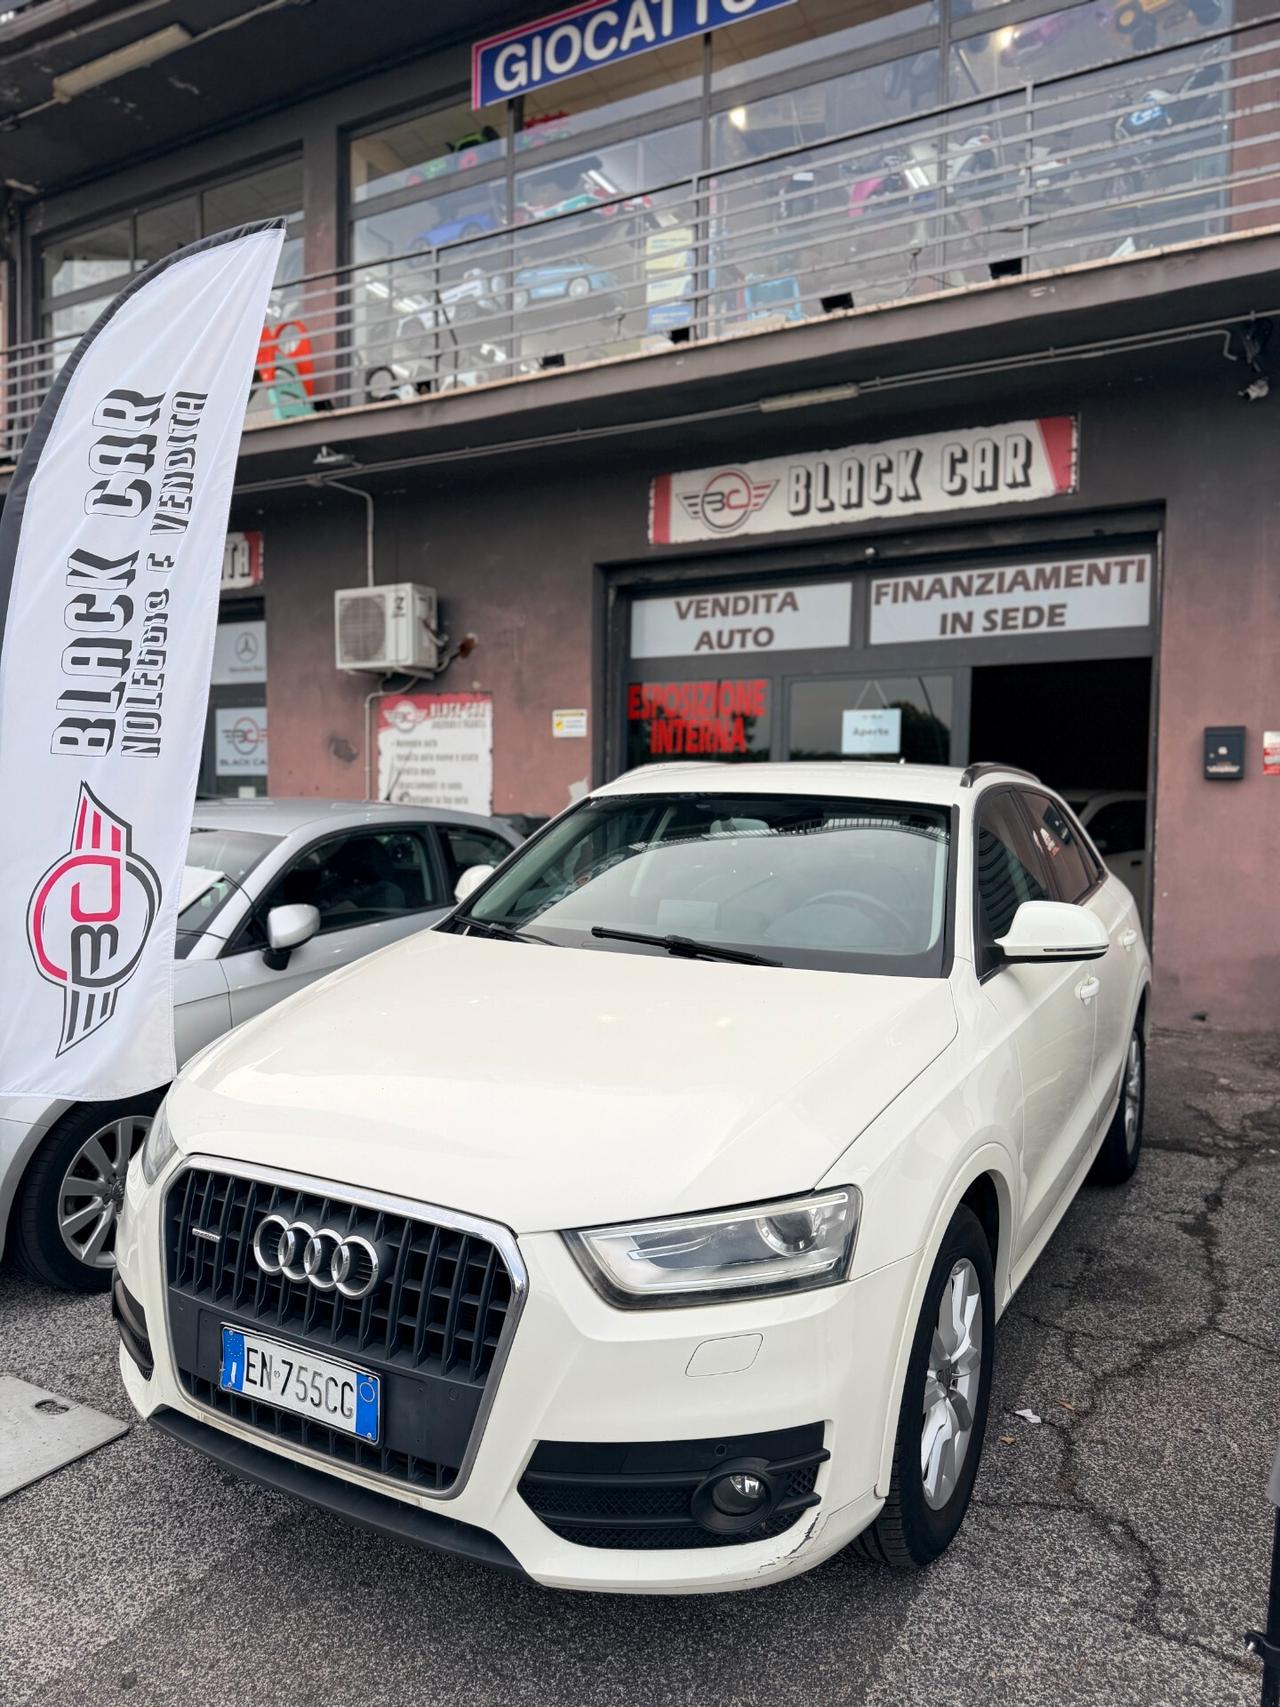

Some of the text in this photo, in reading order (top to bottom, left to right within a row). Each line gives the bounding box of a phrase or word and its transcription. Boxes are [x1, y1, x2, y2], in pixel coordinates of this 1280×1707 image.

[493, 0, 759, 92] GIOCATT
[787, 448, 923, 516] BLACK
[940, 434, 1033, 497] CAR
[50, 389, 166, 758] BLACK CAR
[120, 391, 208, 759] NOLEGGIO E VENDITA
[873, 558, 1147, 606] FINANZIAMENTI
[674, 590, 800, 621] VENDITA
[939, 604, 1067, 637] IN SEDE
[694, 626, 775, 652] AUTO
[627, 679, 769, 720] ESPOSIZIONE
[650, 716, 747, 754] INTERNA
[252, 757, 267, 766] CA
